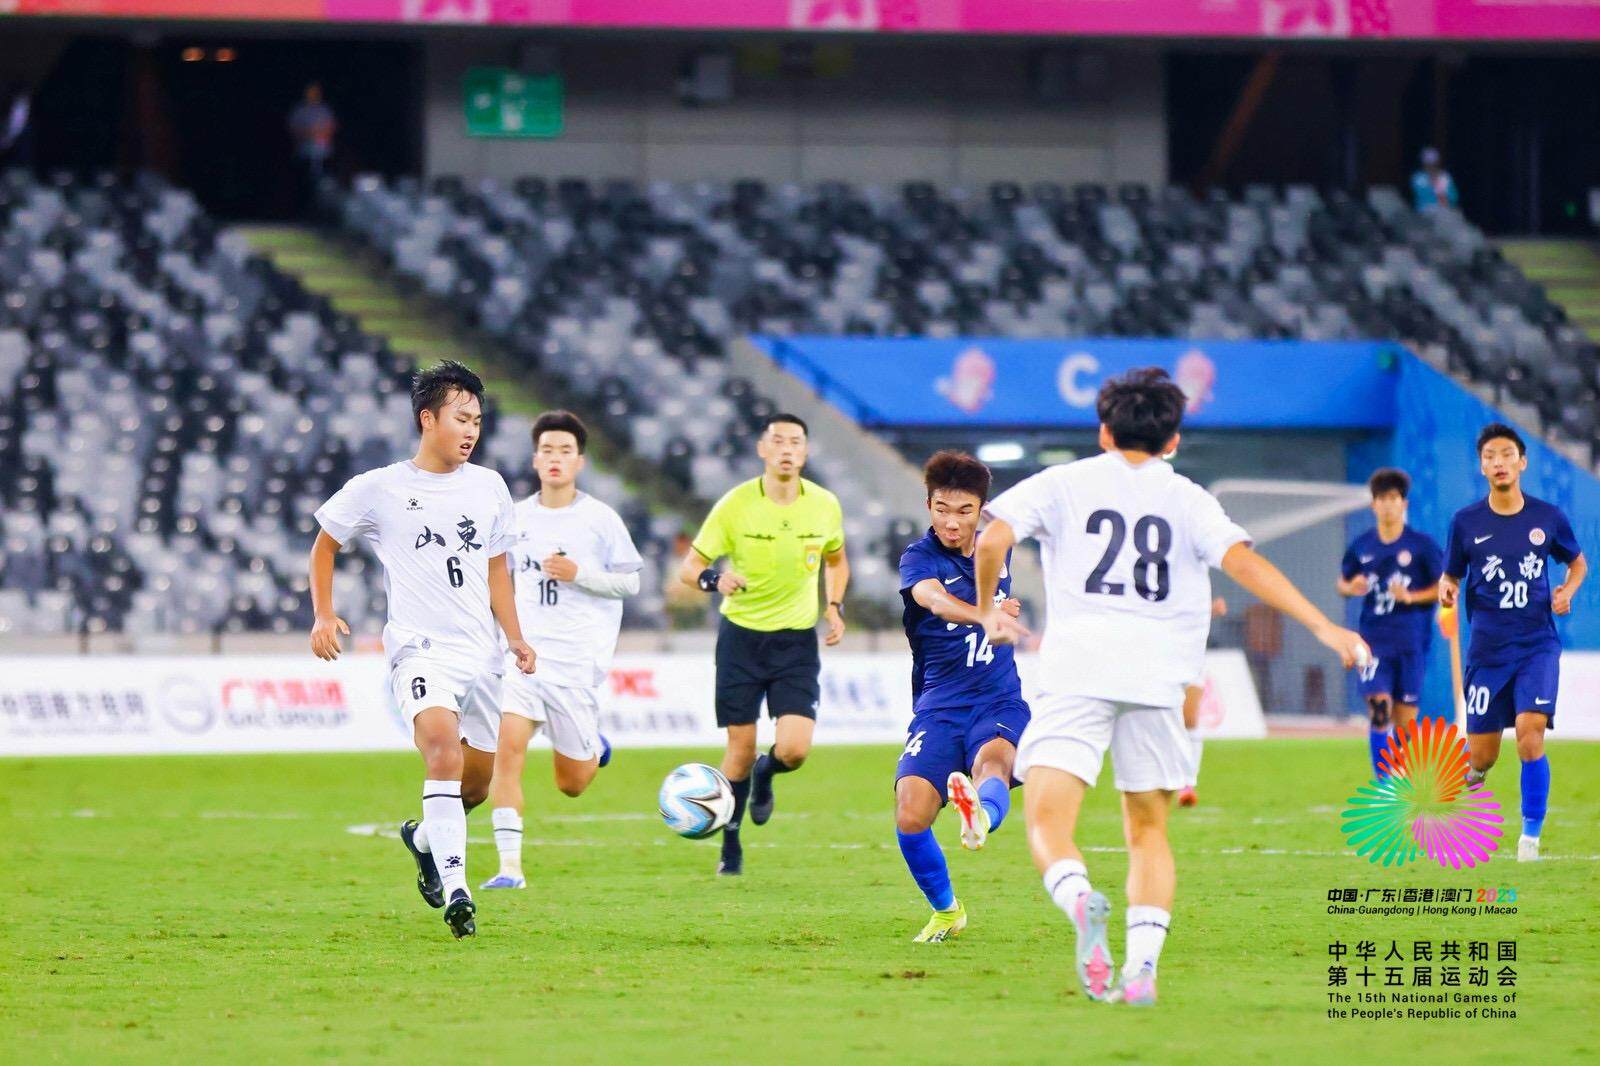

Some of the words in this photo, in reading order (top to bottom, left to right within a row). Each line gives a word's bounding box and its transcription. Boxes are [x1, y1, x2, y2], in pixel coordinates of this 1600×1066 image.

[1058, 353, 1099, 407] C
[1085, 509, 1172, 602] 28
[1482, 552, 1545, 582] 云南
[446, 556, 464, 588] 6
[537, 579, 558, 606] 16
[1500, 581, 1528, 609] 20
[965, 632, 994, 667] 14
[411, 676, 427, 700] 6
[1467, 685, 1490, 715] 20
